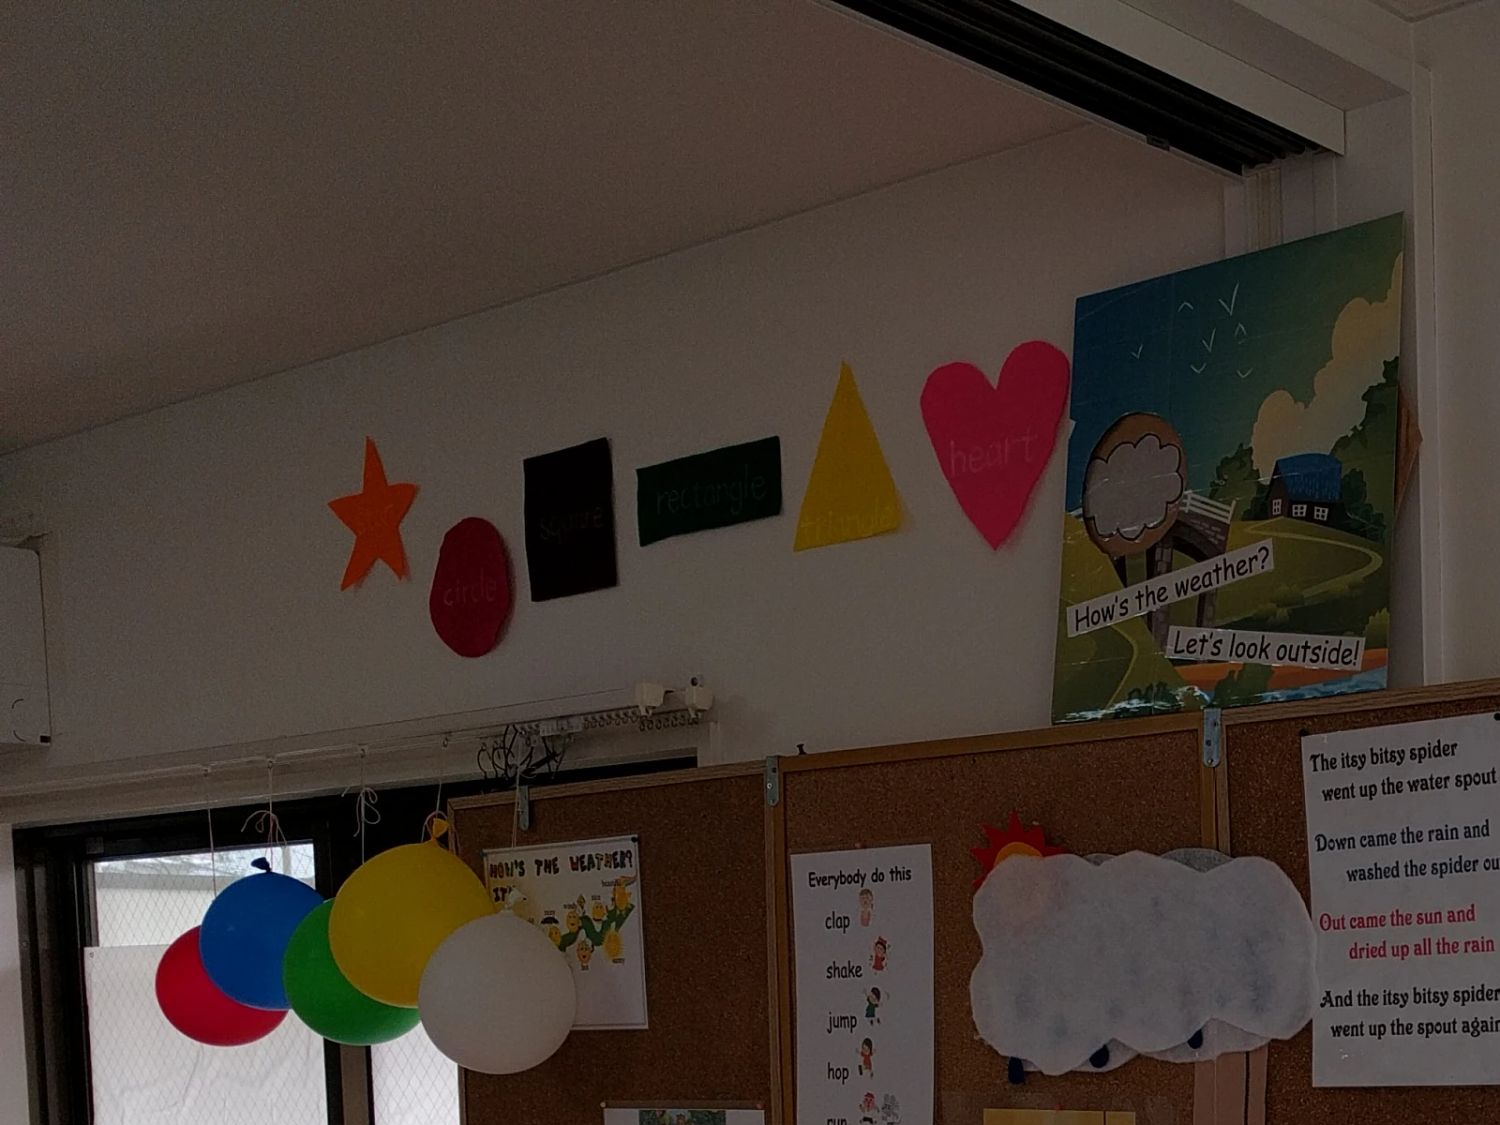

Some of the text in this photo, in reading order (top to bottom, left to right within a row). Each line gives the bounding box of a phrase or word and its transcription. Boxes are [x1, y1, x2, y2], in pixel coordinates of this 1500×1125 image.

[950, 432, 1037, 477] heart
[655, 464, 768, 516] rectangle
[443, 567, 498, 607] circle
[1076, 547, 1269, 632] How's the weather?
[1172, 630, 1360, 666] Let's look outside!
[1310, 739, 1458, 772] The itsy bitsy spider
[1322, 768, 1497, 801] went up the water spout
[1315, 819, 1490, 852] Down came the rain and
[535, 857, 559, 876] THE
[569, 850, 633, 872] WEATHER?
[808, 866, 911, 887] Everybody do this
[1346, 860, 1400, 882] washed
[1404, 859, 1427, 877] the
[1431, 855, 1479, 878] spider
[825, 911, 850, 934] clap
[1320, 904, 1475, 931] Out came the sun and
[1349, 936, 1494, 959] dried up all the rain
[826, 961, 862, 979] shake
[827, 1012, 857, 1034] jump
[828, 1062, 849, 1084] hop
